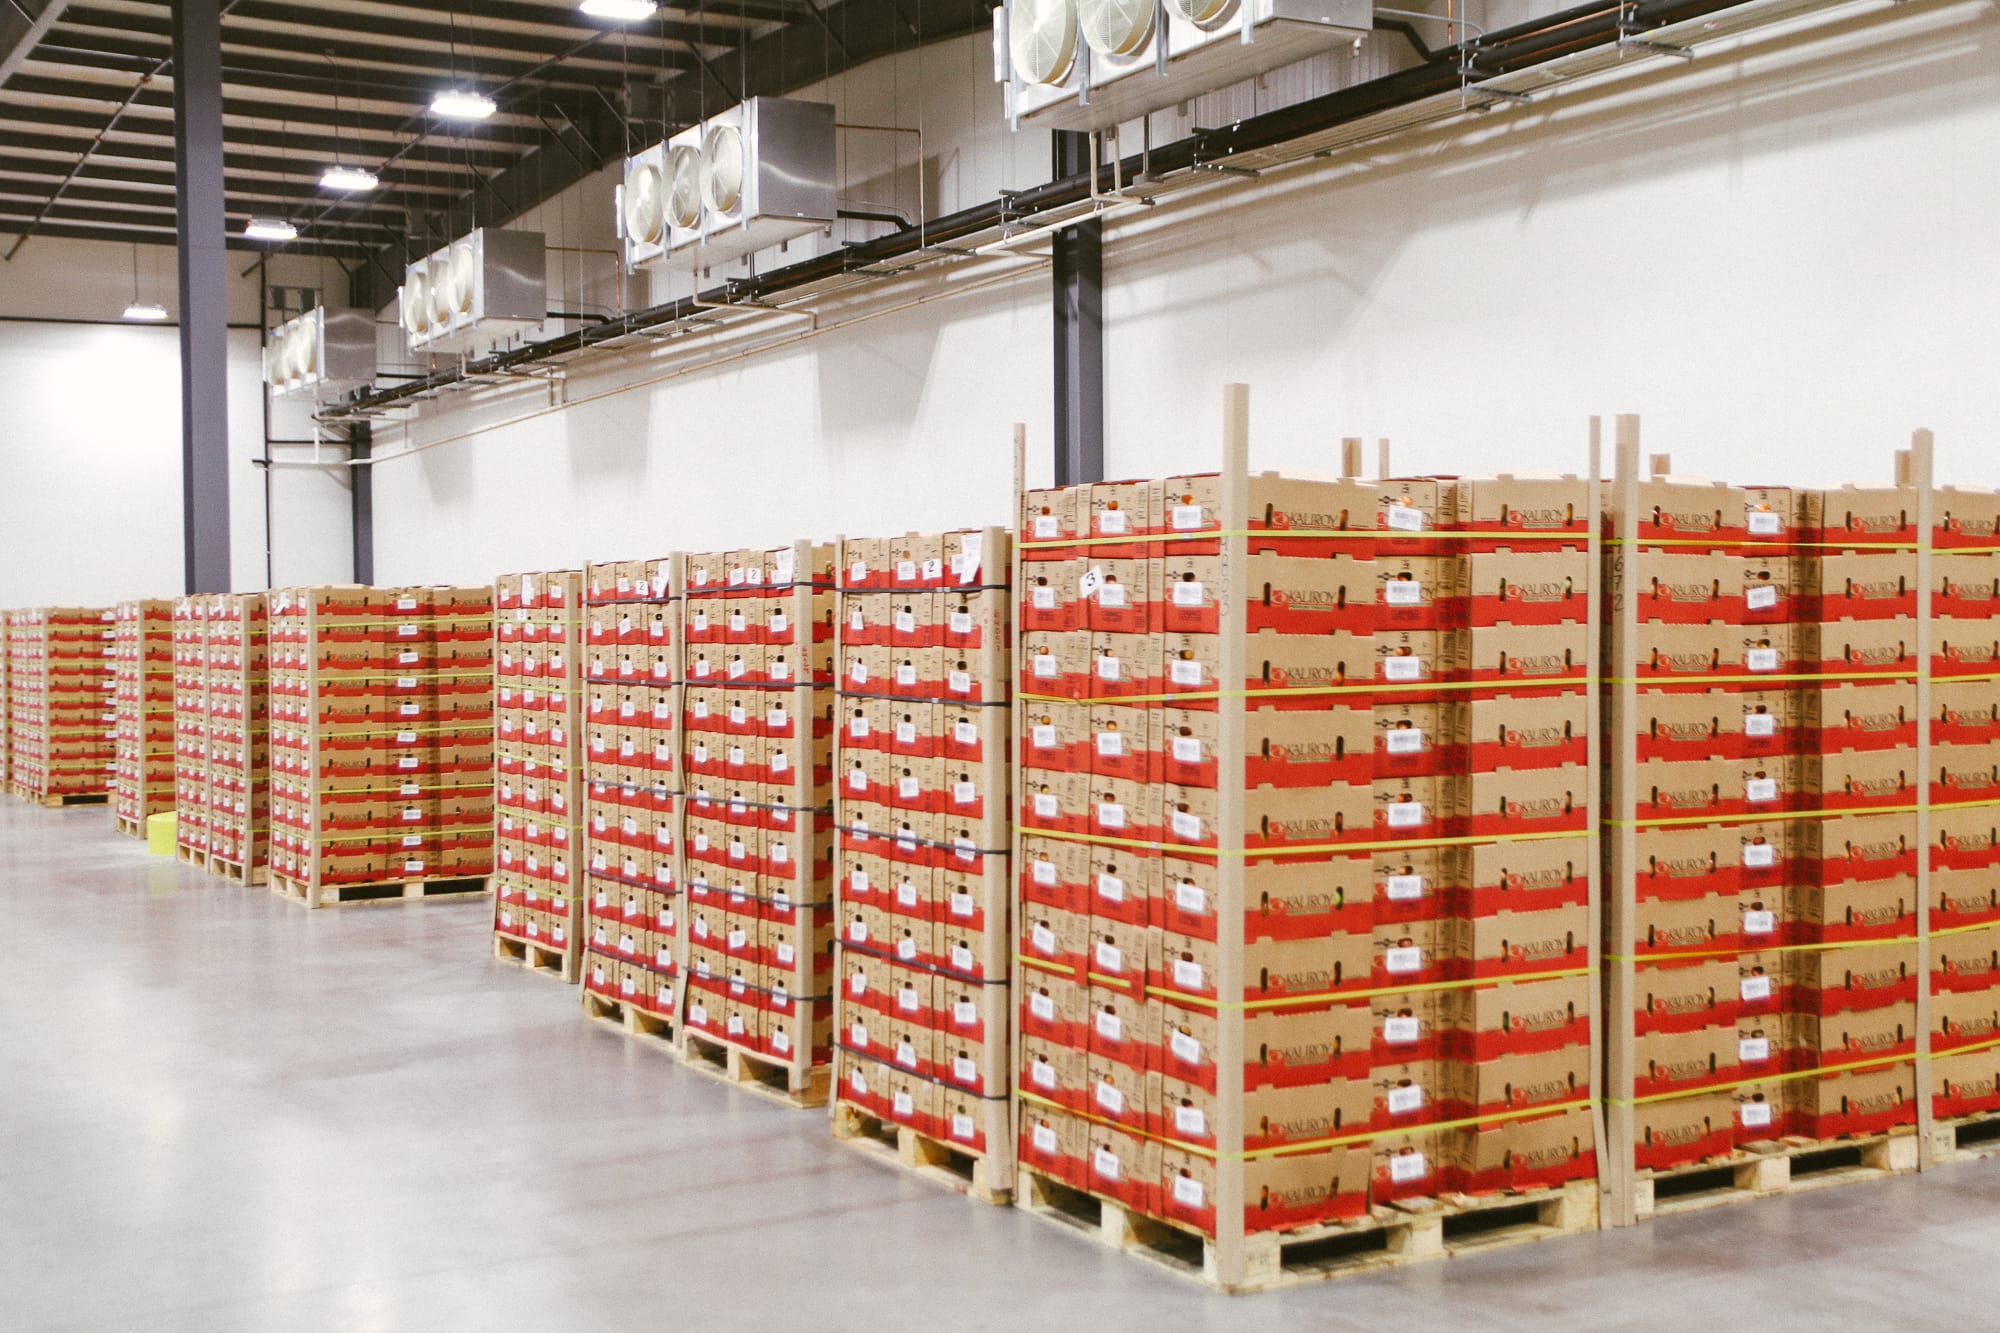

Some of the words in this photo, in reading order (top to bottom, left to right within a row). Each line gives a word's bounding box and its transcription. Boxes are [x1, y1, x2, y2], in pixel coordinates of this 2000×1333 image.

[1290, 513, 1338, 527] KALIROY
[1522, 509, 1564, 521] KALIROY
[928, 560, 935, 573] 2
[751, 569, 757, 580] 2
[1086, 572, 1096, 587] 3
[1521, 583, 1561, 595] KALIROY
[1289, 590, 1335, 603] KALIROY
[1521, 656, 1561, 668] KALIROY
[1287, 667, 1333, 680] KALIROY
[1520, 728, 1561, 741] KALIROY
[1287, 743, 1333, 755] KALIROY
[1521, 799, 1562, 812] KALIROY
[1286, 818, 1331, 832] KALIROY
